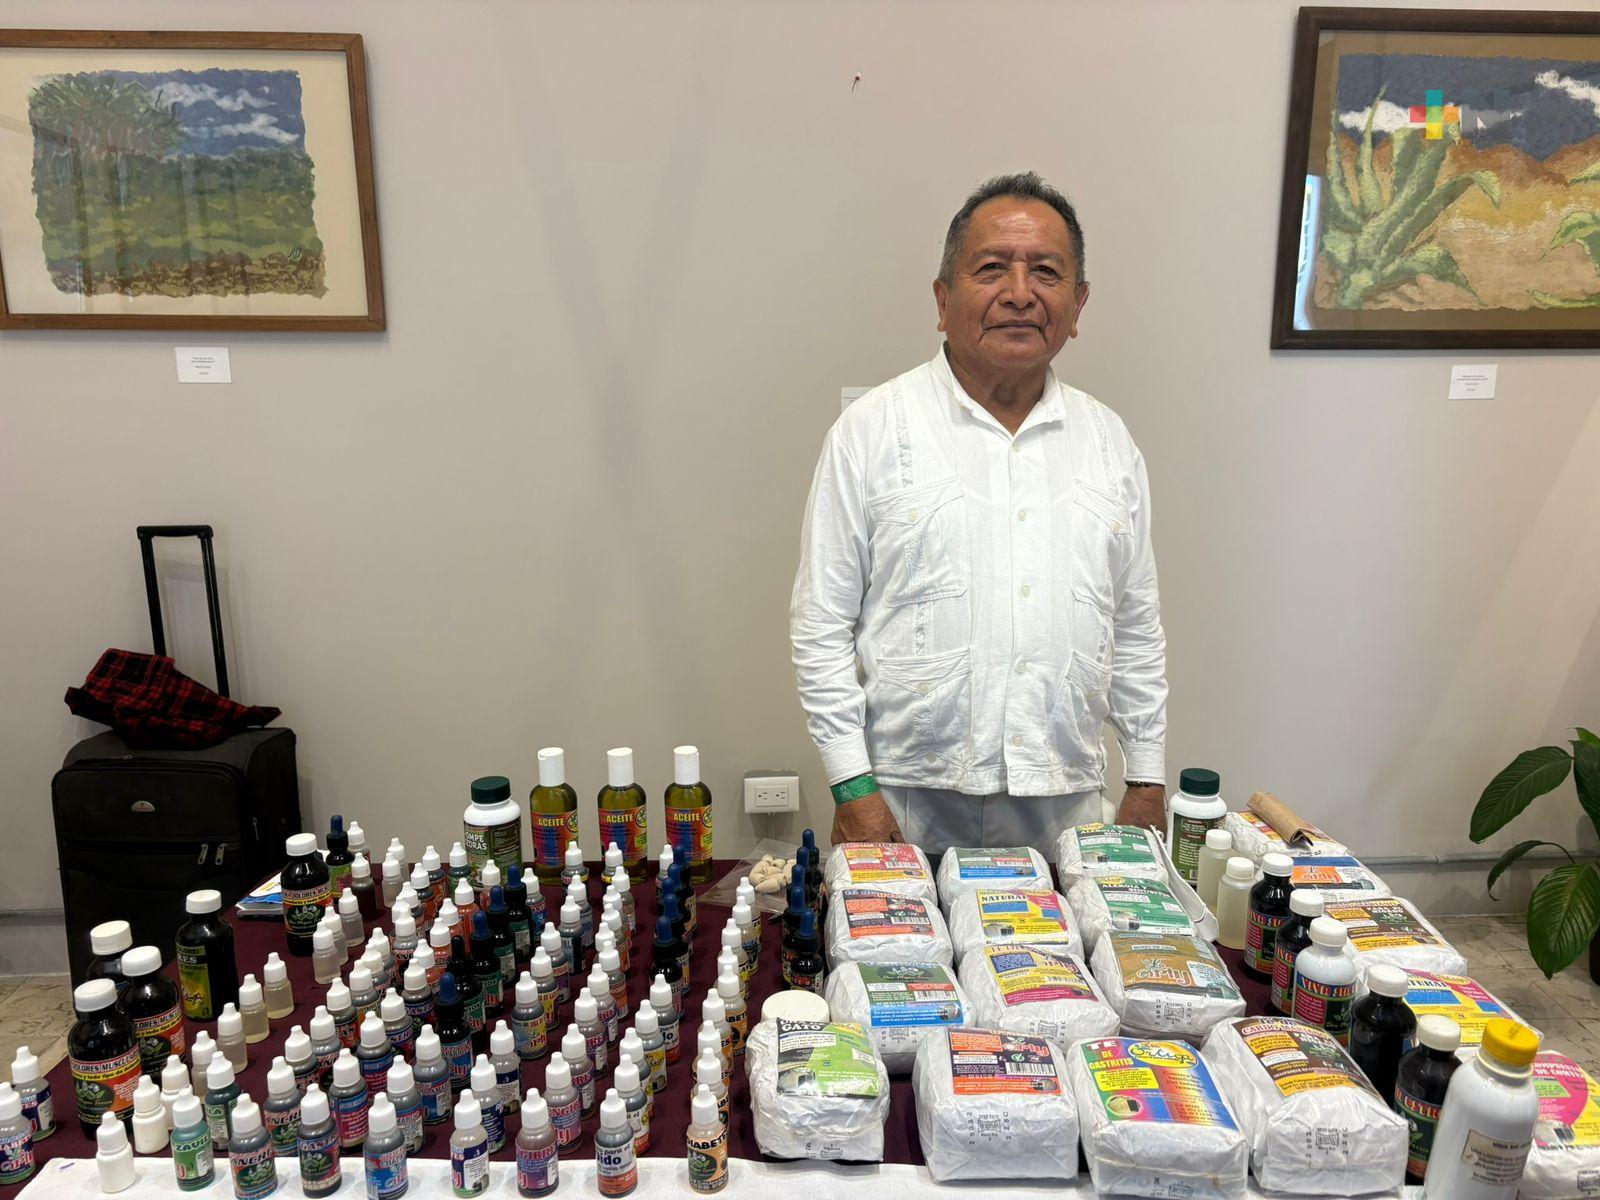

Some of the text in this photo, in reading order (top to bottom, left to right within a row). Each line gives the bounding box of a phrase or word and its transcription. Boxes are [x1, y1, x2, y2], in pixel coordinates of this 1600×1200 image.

[538, 817, 565, 827] ACEITE
[606, 813, 634, 824] ACEITE
[673, 812, 701, 822] ACEITE
[465, 831, 485, 843] OMPE
[781, 1023, 821, 1031] GATO
[1086, 1039, 1118, 1050] TE
[1101, 1050, 1114, 1058] DE
[1088, 1058, 1134, 1070] GASTRITIS
